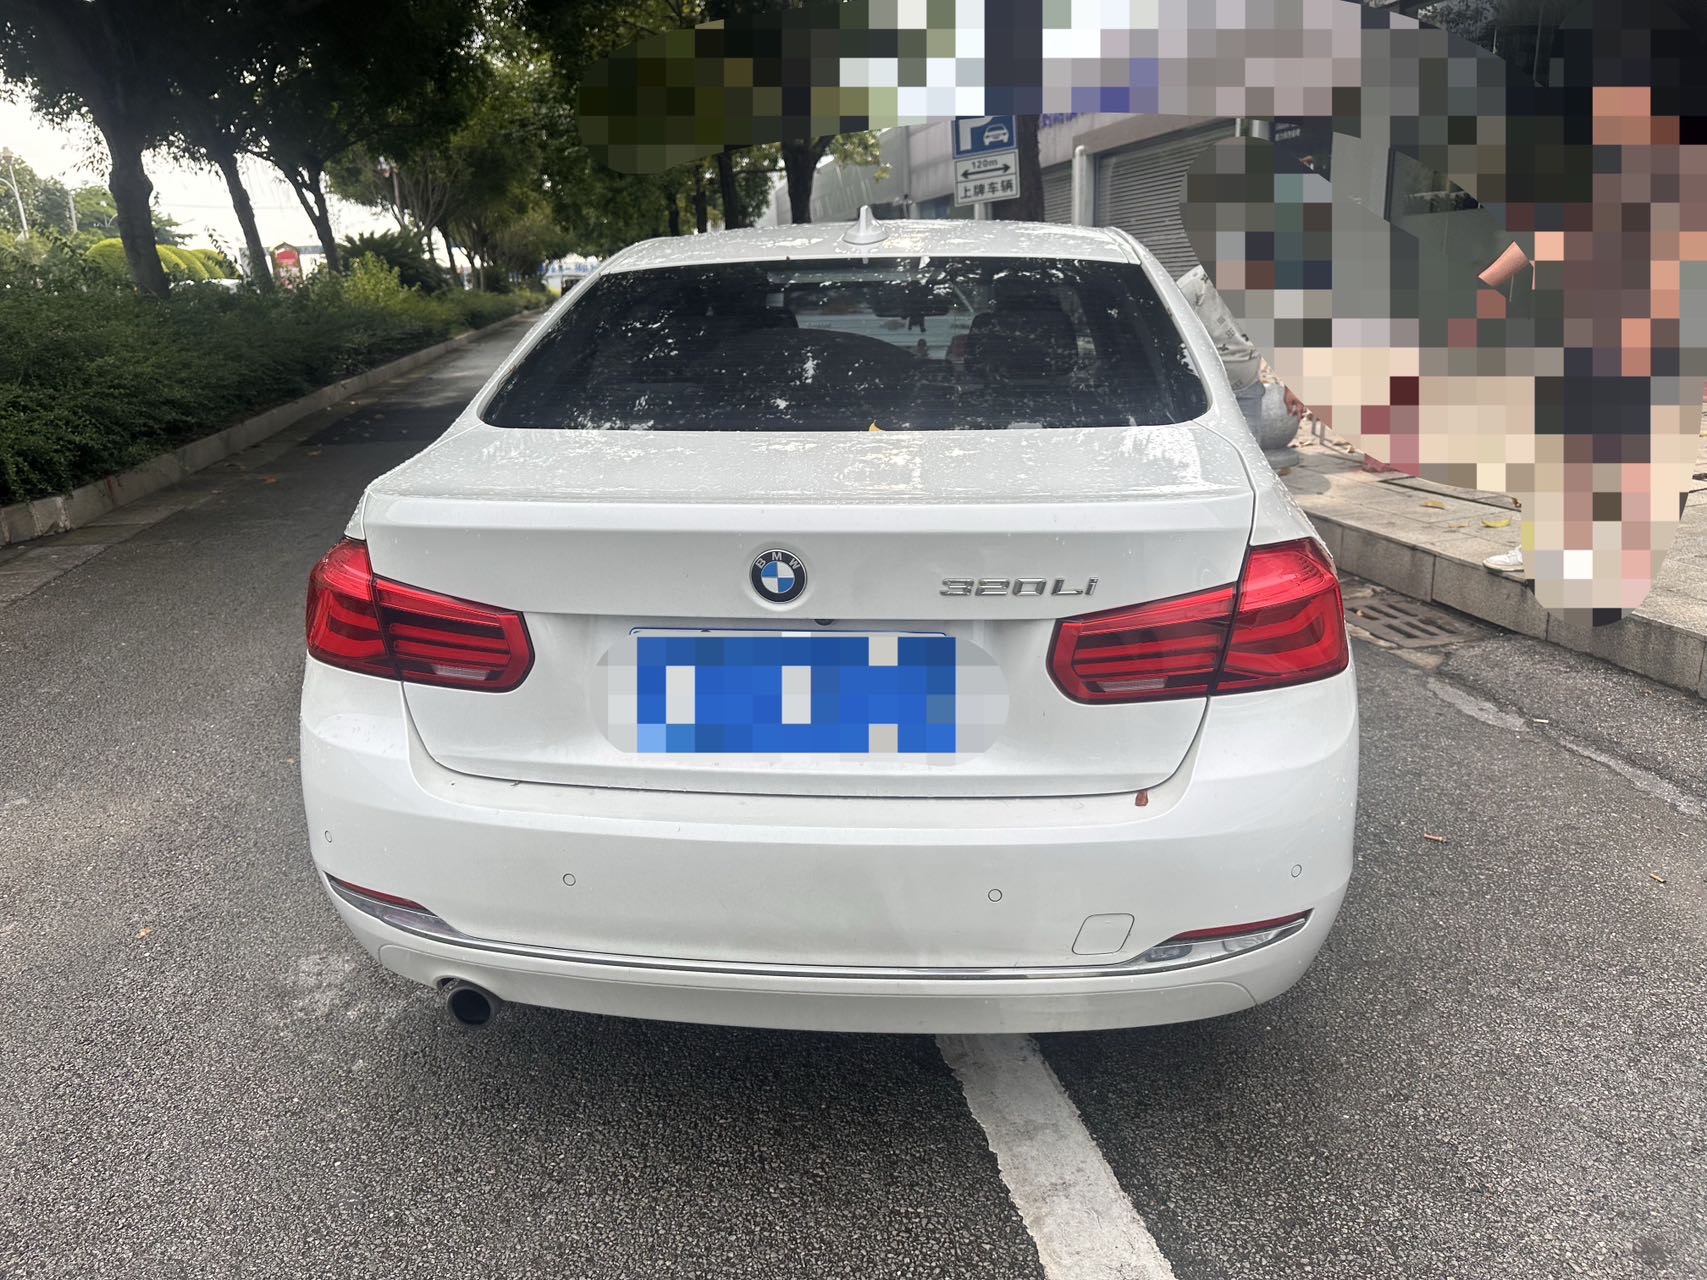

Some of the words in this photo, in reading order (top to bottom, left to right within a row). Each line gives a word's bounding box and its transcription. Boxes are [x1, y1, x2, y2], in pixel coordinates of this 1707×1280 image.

[971, 160, 998, 169] 120m
[960, 179, 1013, 199] 上牌车辆
[755, 551, 800, 570] BMW
[939, 577, 1099, 596] 320Li
